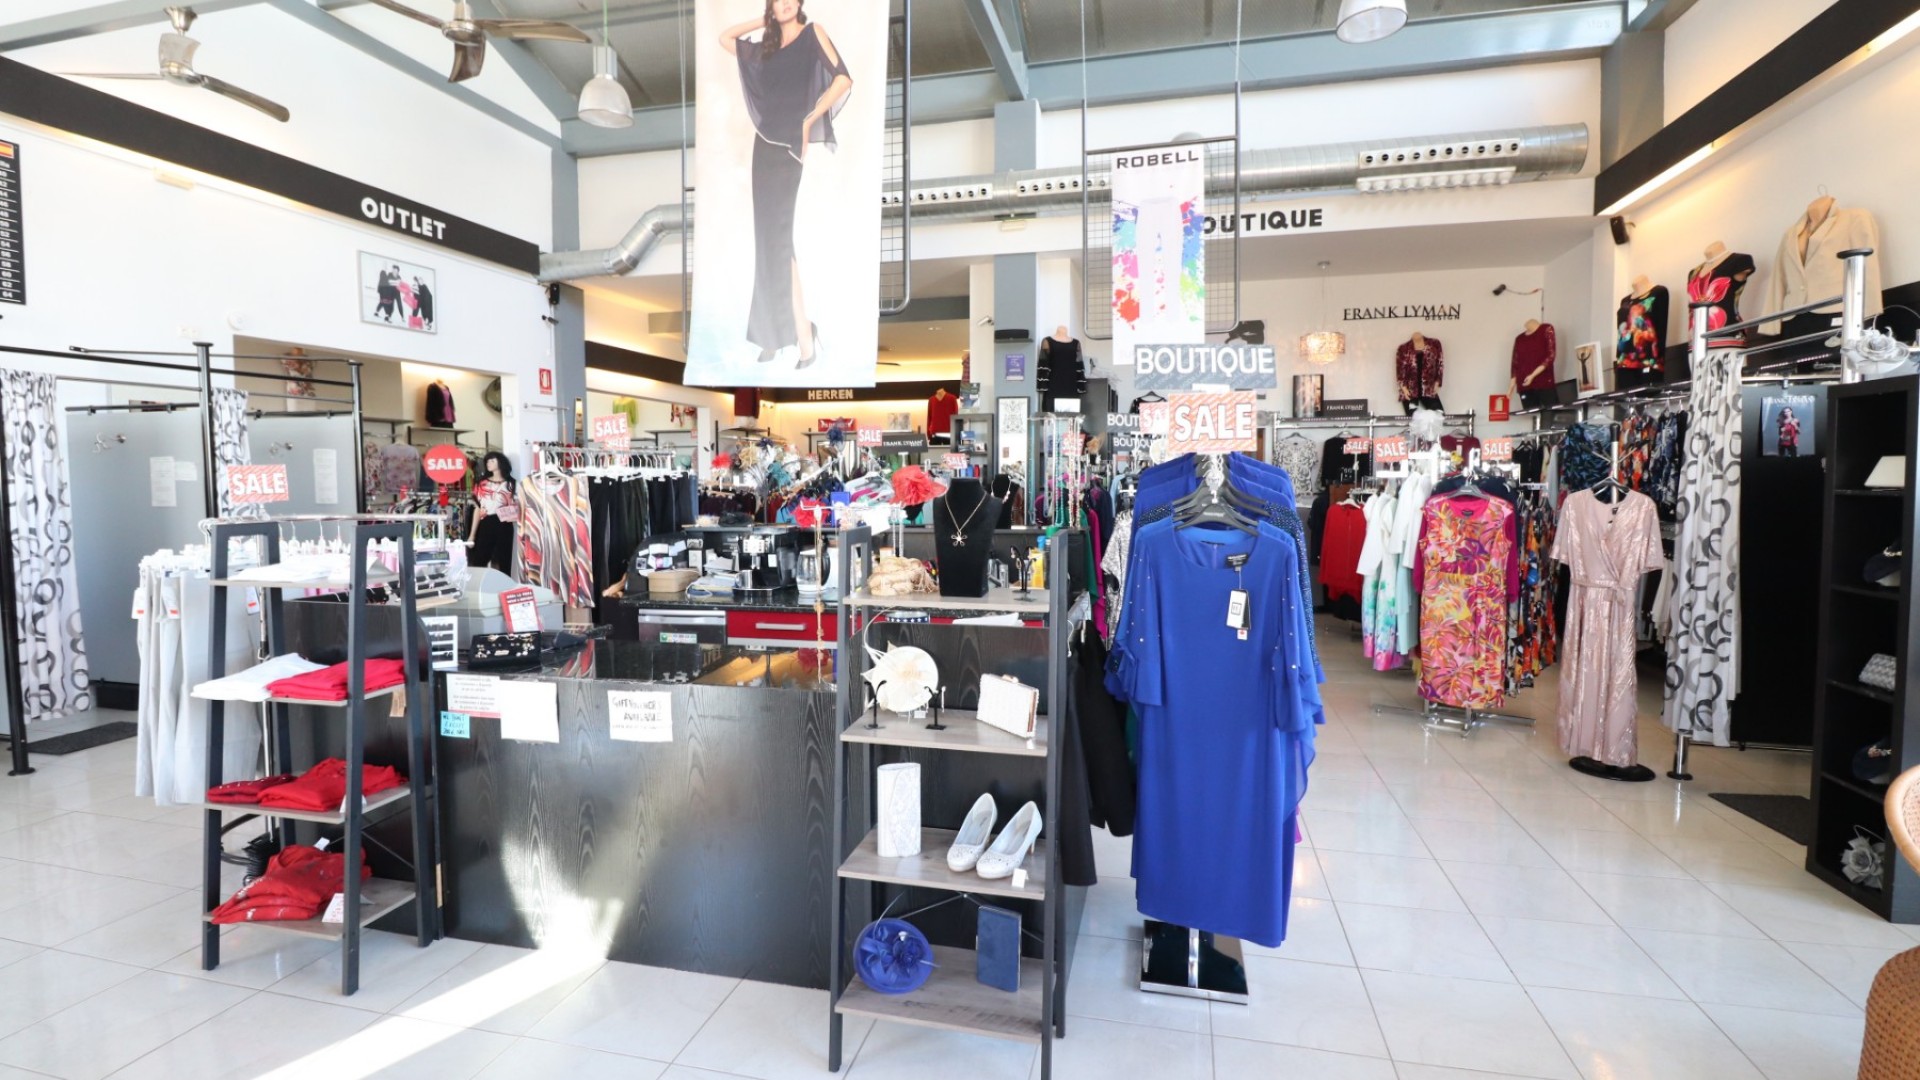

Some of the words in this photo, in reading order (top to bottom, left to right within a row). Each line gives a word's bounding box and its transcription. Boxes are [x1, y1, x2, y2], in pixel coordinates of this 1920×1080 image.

[1117, 151, 1199, 169] ROBELL
[361, 197, 446, 240] OUTLET
[1204, 208, 1322, 234] OUTIQUE
[1343, 306, 1398, 320] FRANK
[1403, 304, 1461, 318] LYMAN
[1137, 347, 1275, 378] BOUTIQUE
[808, 389, 854, 400] HERREN
[1107, 414, 1140, 427] BOUT
[1143, 409, 1167, 429] SA
[1175, 403, 1253, 442] SALE
[596, 418, 627, 437] SALE
[859, 430, 881, 443] SALE
[1113, 437, 1152, 448] BOUTQU
[1346, 440, 1368, 450] SALE
[1376, 441, 1406, 457] SALE
[1484, 442, 1510, 456] SALE
[427, 458, 463, 471] SALE
[947, 456, 968, 466] SALE
[232, 473, 286, 497] SALE
